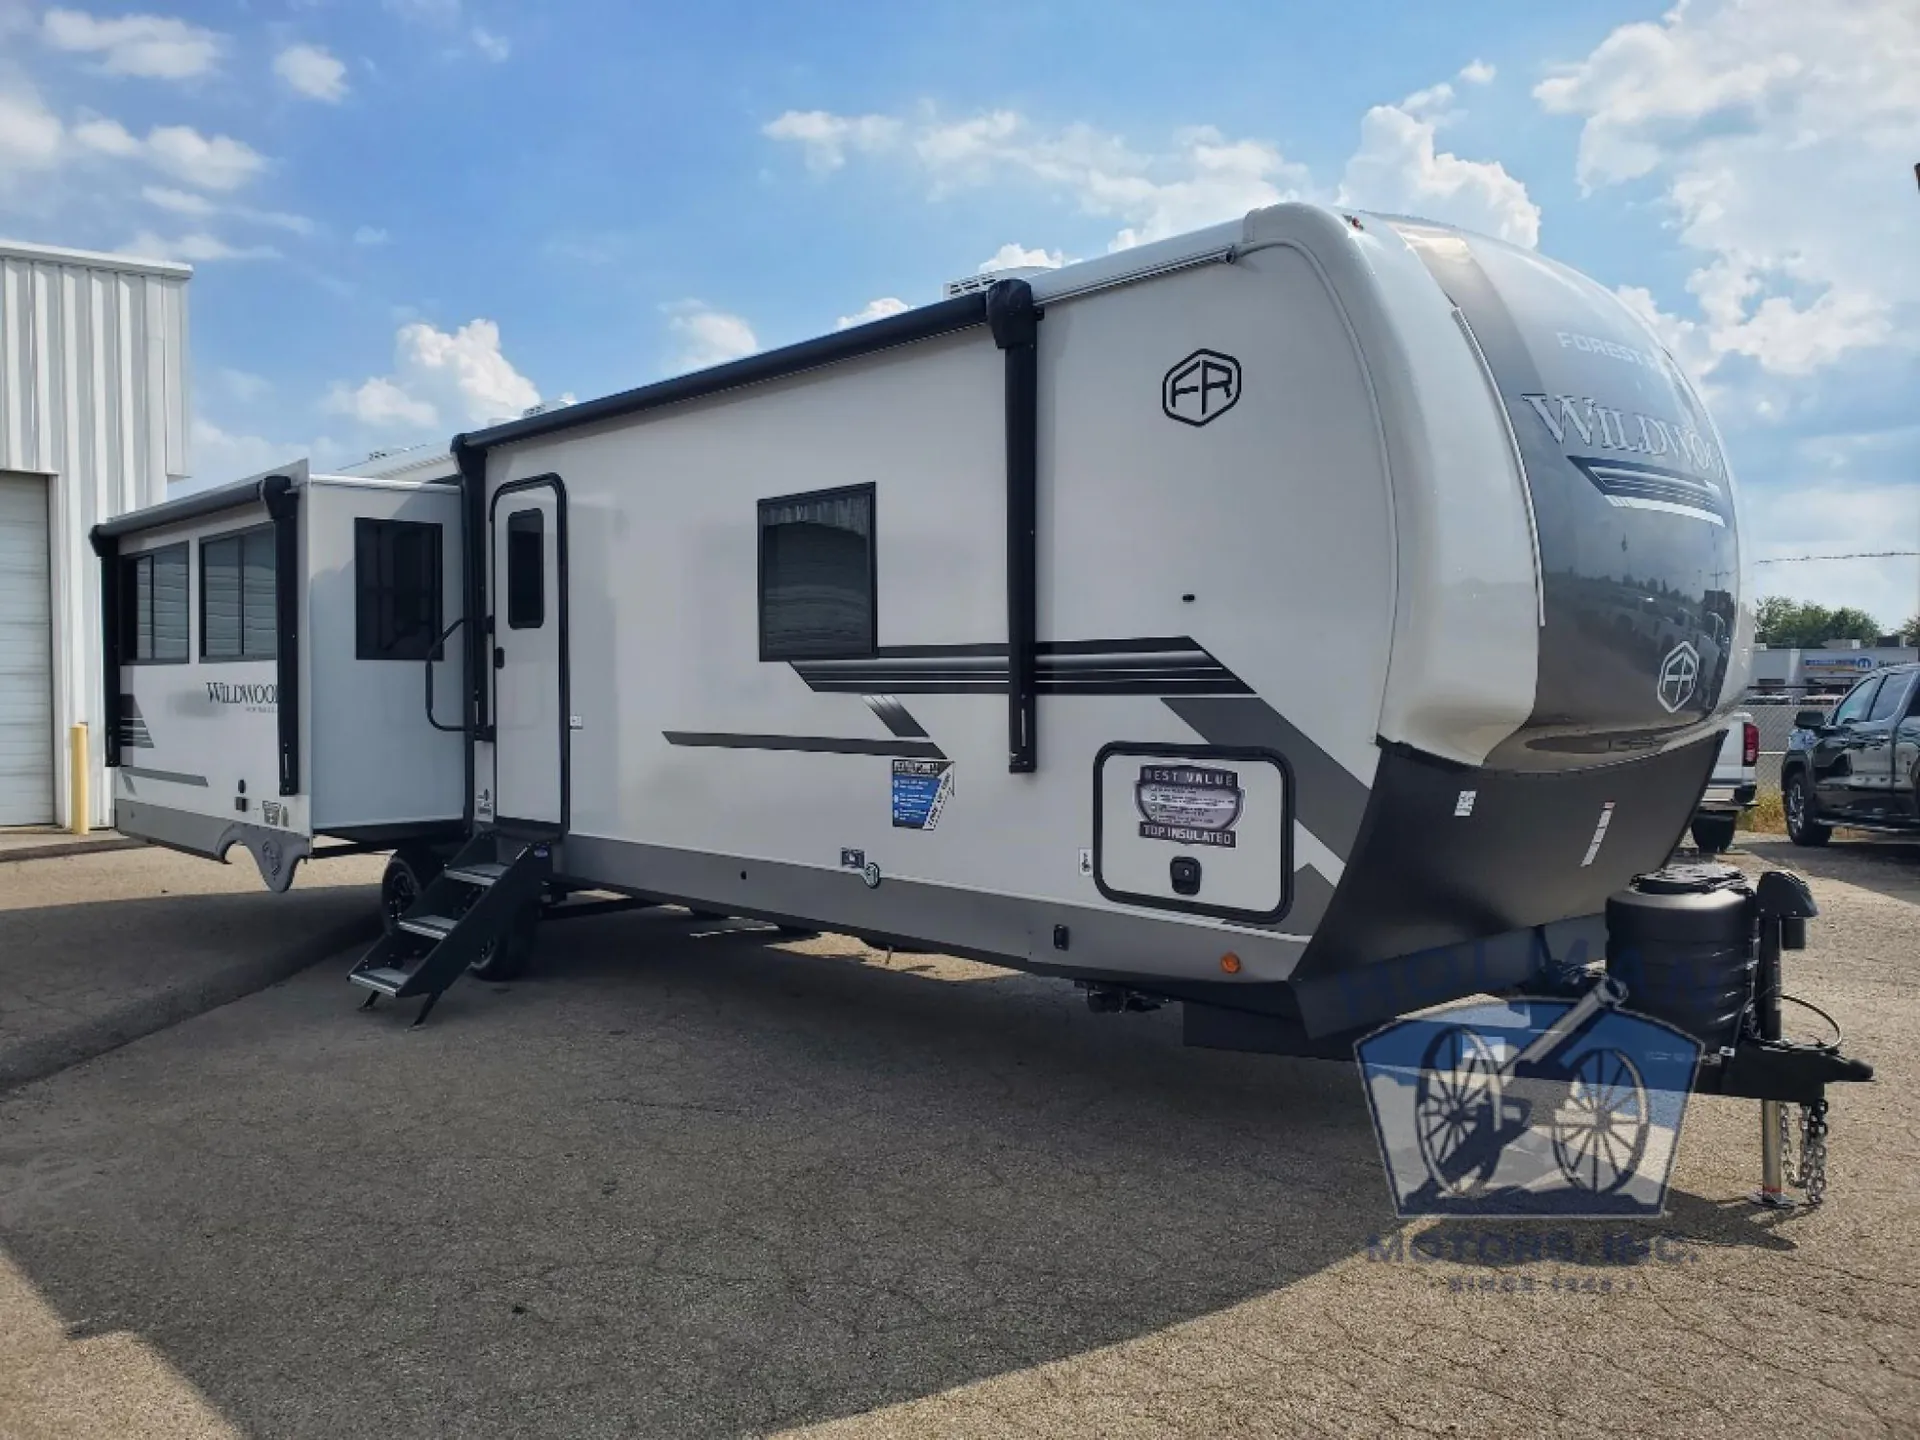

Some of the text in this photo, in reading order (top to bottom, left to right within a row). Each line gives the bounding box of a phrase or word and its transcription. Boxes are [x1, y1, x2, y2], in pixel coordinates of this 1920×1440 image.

[1556, 331, 1644, 365] FOREST
[1186, 772, 1234, 787] VALUE
[1143, 824, 1231, 845] TOP INSULATED
